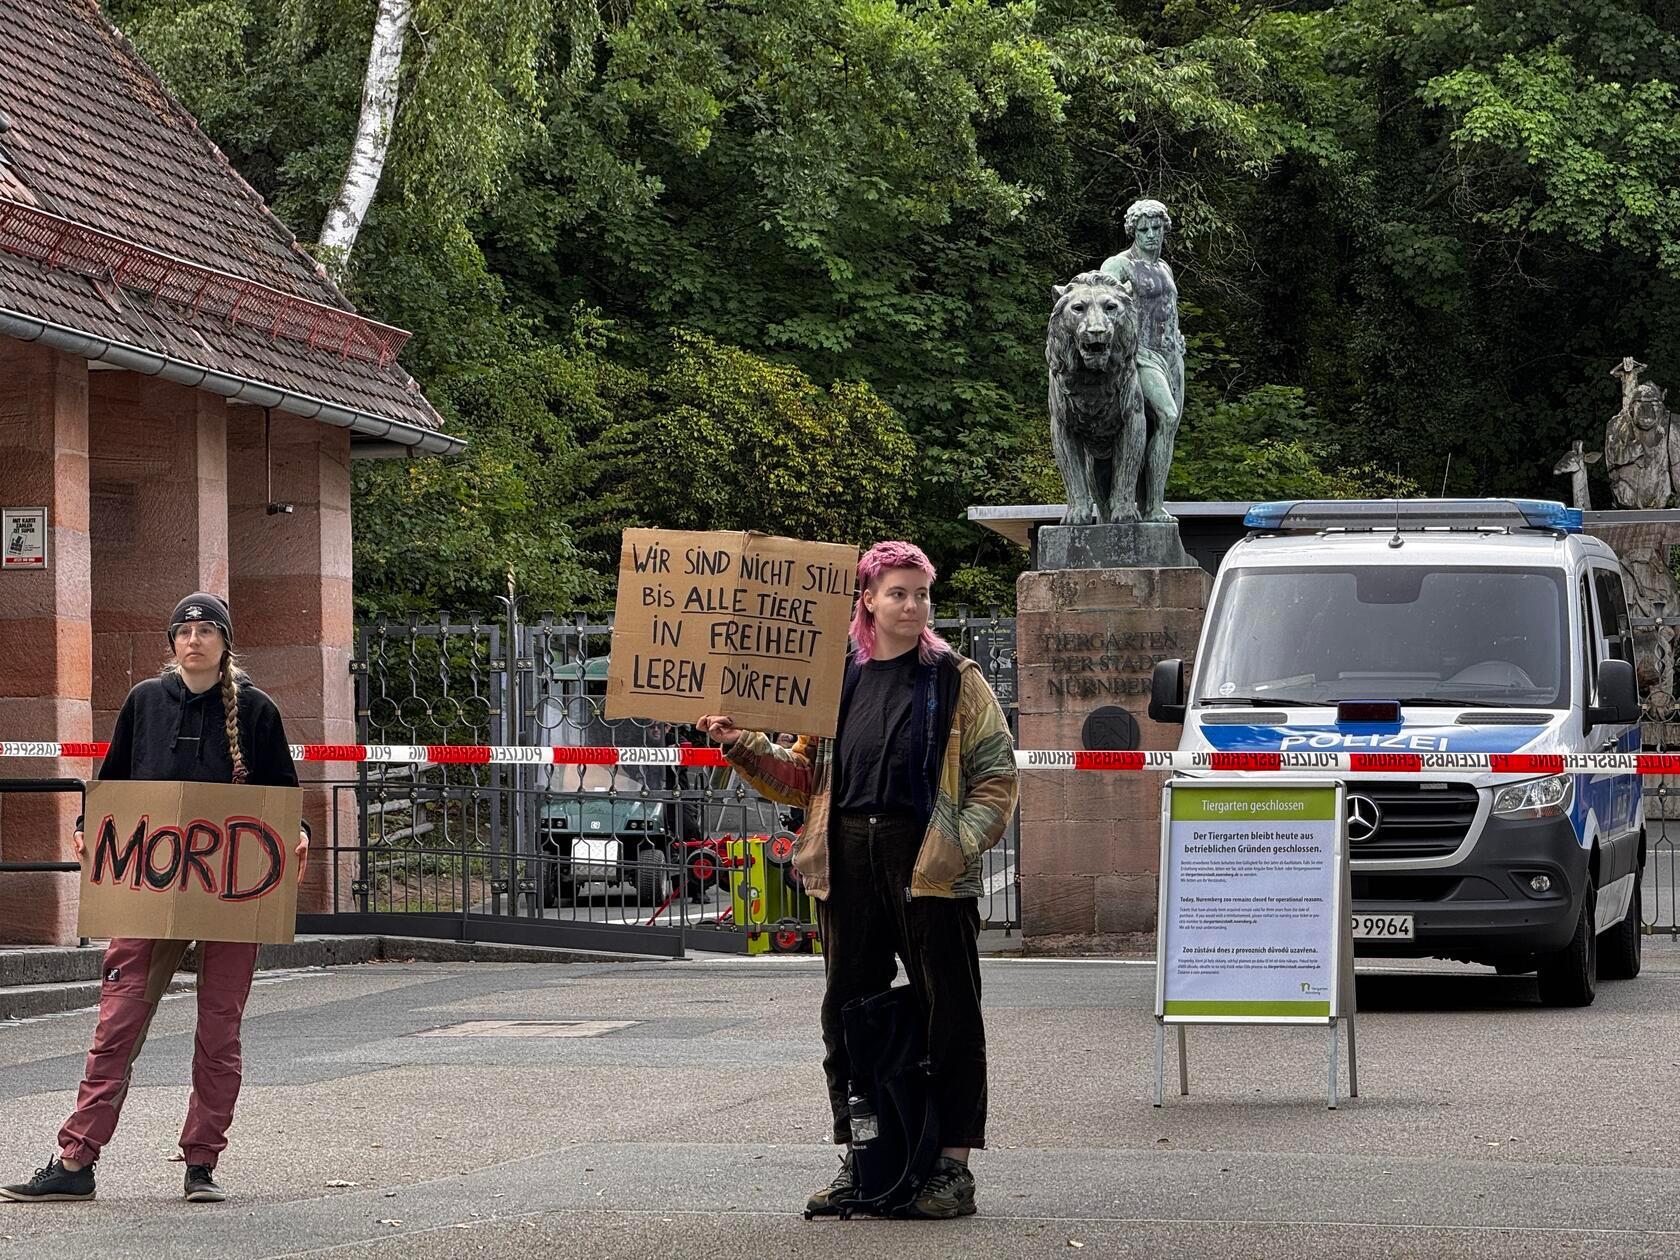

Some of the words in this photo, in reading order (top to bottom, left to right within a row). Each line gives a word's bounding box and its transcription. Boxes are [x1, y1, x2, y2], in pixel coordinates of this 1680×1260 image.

[684, 586, 747, 612] ALLE
[1040, 631, 1178, 651] TIERGARTEN
[1052, 655, 1095, 672] DER
[633, 655, 706, 692] LEBEN
[720, 663, 811, 707] DÜRFEN
[1047, 673, 1153, 697] NÜRNBER
[1279, 733, 1449, 751] POLIZEI
[1201, 800, 1248, 814] Tiergarten
[1250, 799, 1304, 814] geschlossen
[1193, 832, 1207, 840] Der
[1208, 832, 1249, 842] Tiergarten
[1250, 832, 1274, 840] bleibt
[1275, 832, 1299, 840] heute
[90, 813, 286, 902] MORD
[1184, 845, 1236, 853] betrieblichen
[1237, 844, 1271, 853] Gründen
[1272, 844, 1322, 855] geschlossen.
[1363, 917, 1410, 935] 9964
[1182, 946, 1194, 954] Zoo
[1216, 946, 1231, 954] dnes
